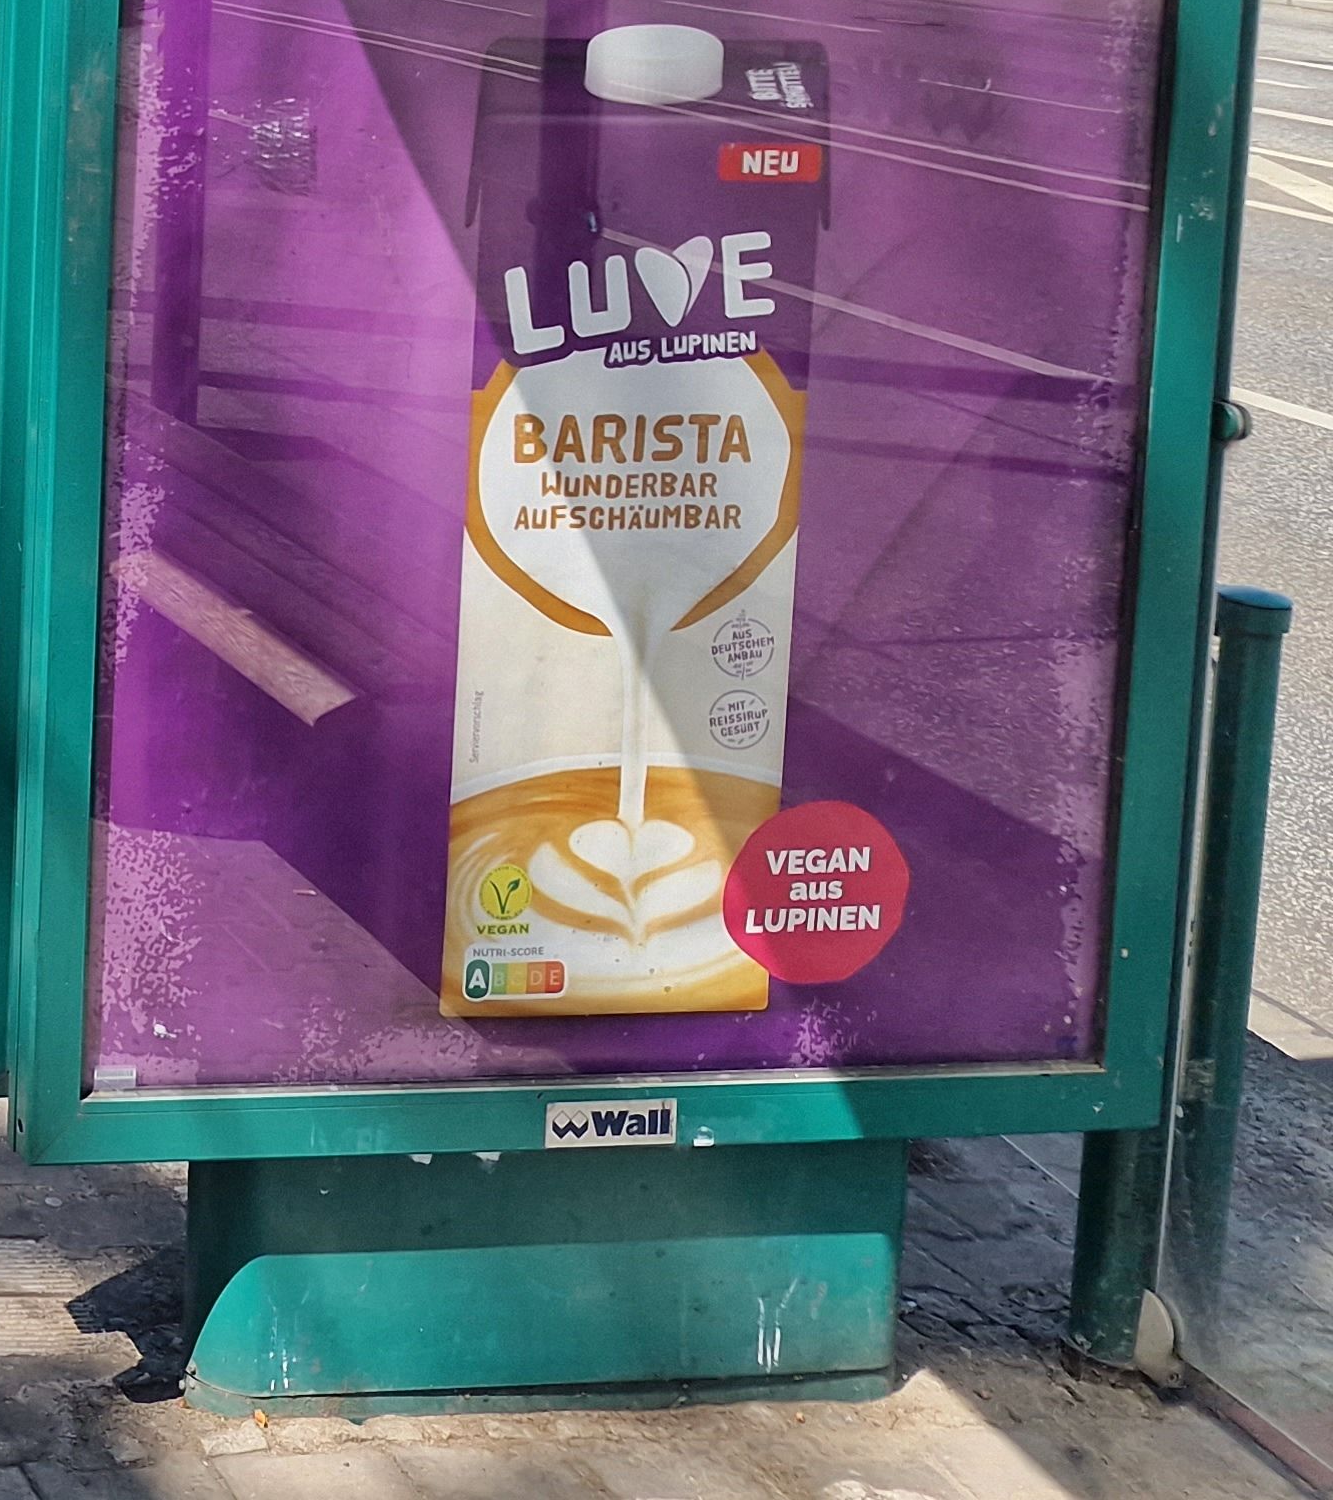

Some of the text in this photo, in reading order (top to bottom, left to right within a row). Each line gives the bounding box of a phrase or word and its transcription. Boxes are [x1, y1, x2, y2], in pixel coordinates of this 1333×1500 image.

[741, 149, 798, 176] NEU
[608, 331, 757, 365] AUS LUPINEN
[513, 413, 751, 464] BARISTA
[541, 471, 718, 498] WUNDERBAR
[514, 504, 742, 530] AUFSCHÄUMBAR
[711, 636, 774, 655] DEUTSCHEM
[732, 629, 752, 641] AUS
[728, 650, 762, 663] ANBAU
[728, 700, 746, 713] MIT
[709, 708, 768, 727] REISSIRUP
[766, 846, 870, 875] VEGAN
[789, 880, 843, 900] aus
[476, 923, 530, 935] VEGAN
[745, 904, 881, 934] LUPINEN
[473, 946, 544, 957] NUTRI-SCORE
[468, 968, 487, 989] A
[591, 1109, 671, 1136] Wall
